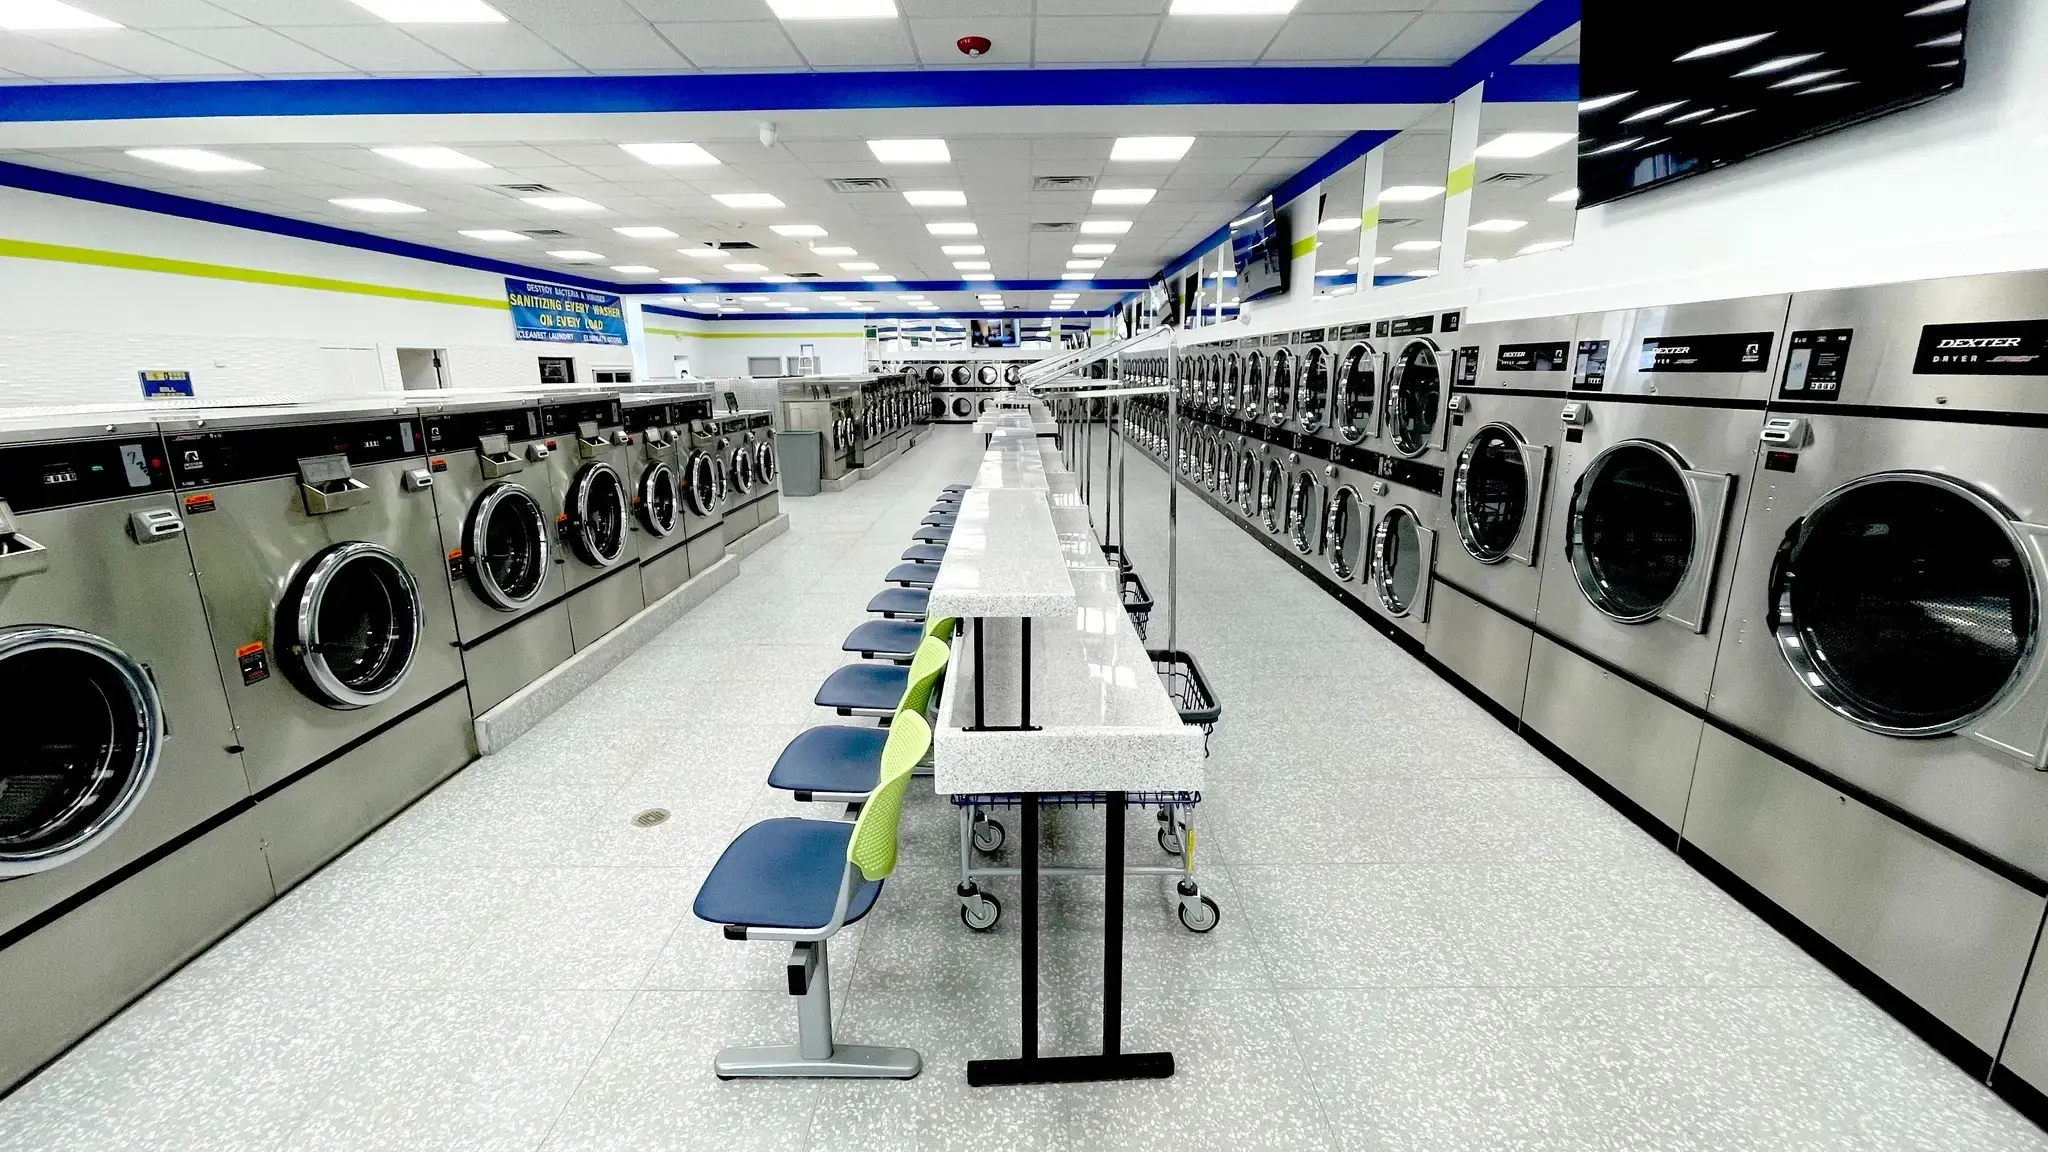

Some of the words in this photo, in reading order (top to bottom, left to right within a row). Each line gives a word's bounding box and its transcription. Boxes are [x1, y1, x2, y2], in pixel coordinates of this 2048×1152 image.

[526, 283, 552, 294] DESTROY
[555, 287, 579, 298] BACTERIA
[510, 293, 562, 311] SANITIZING
[565, 300, 589, 314] EVERY
[592, 305, 621, 318] WASHER
[540, 313, 553, 326] ON
[556, 315, 580, 328] EVERY
[585, 318, 603, 330] LOAD
[518, 330, 547, 339] CLEANEST
[549, 332, 574, 340] LAUNDRY
[1936, 337, 2021, 348] DEXTER
[1652, 346, 1690, 354] DEXTER
[1932, 355, 1978, 363] DRYER
